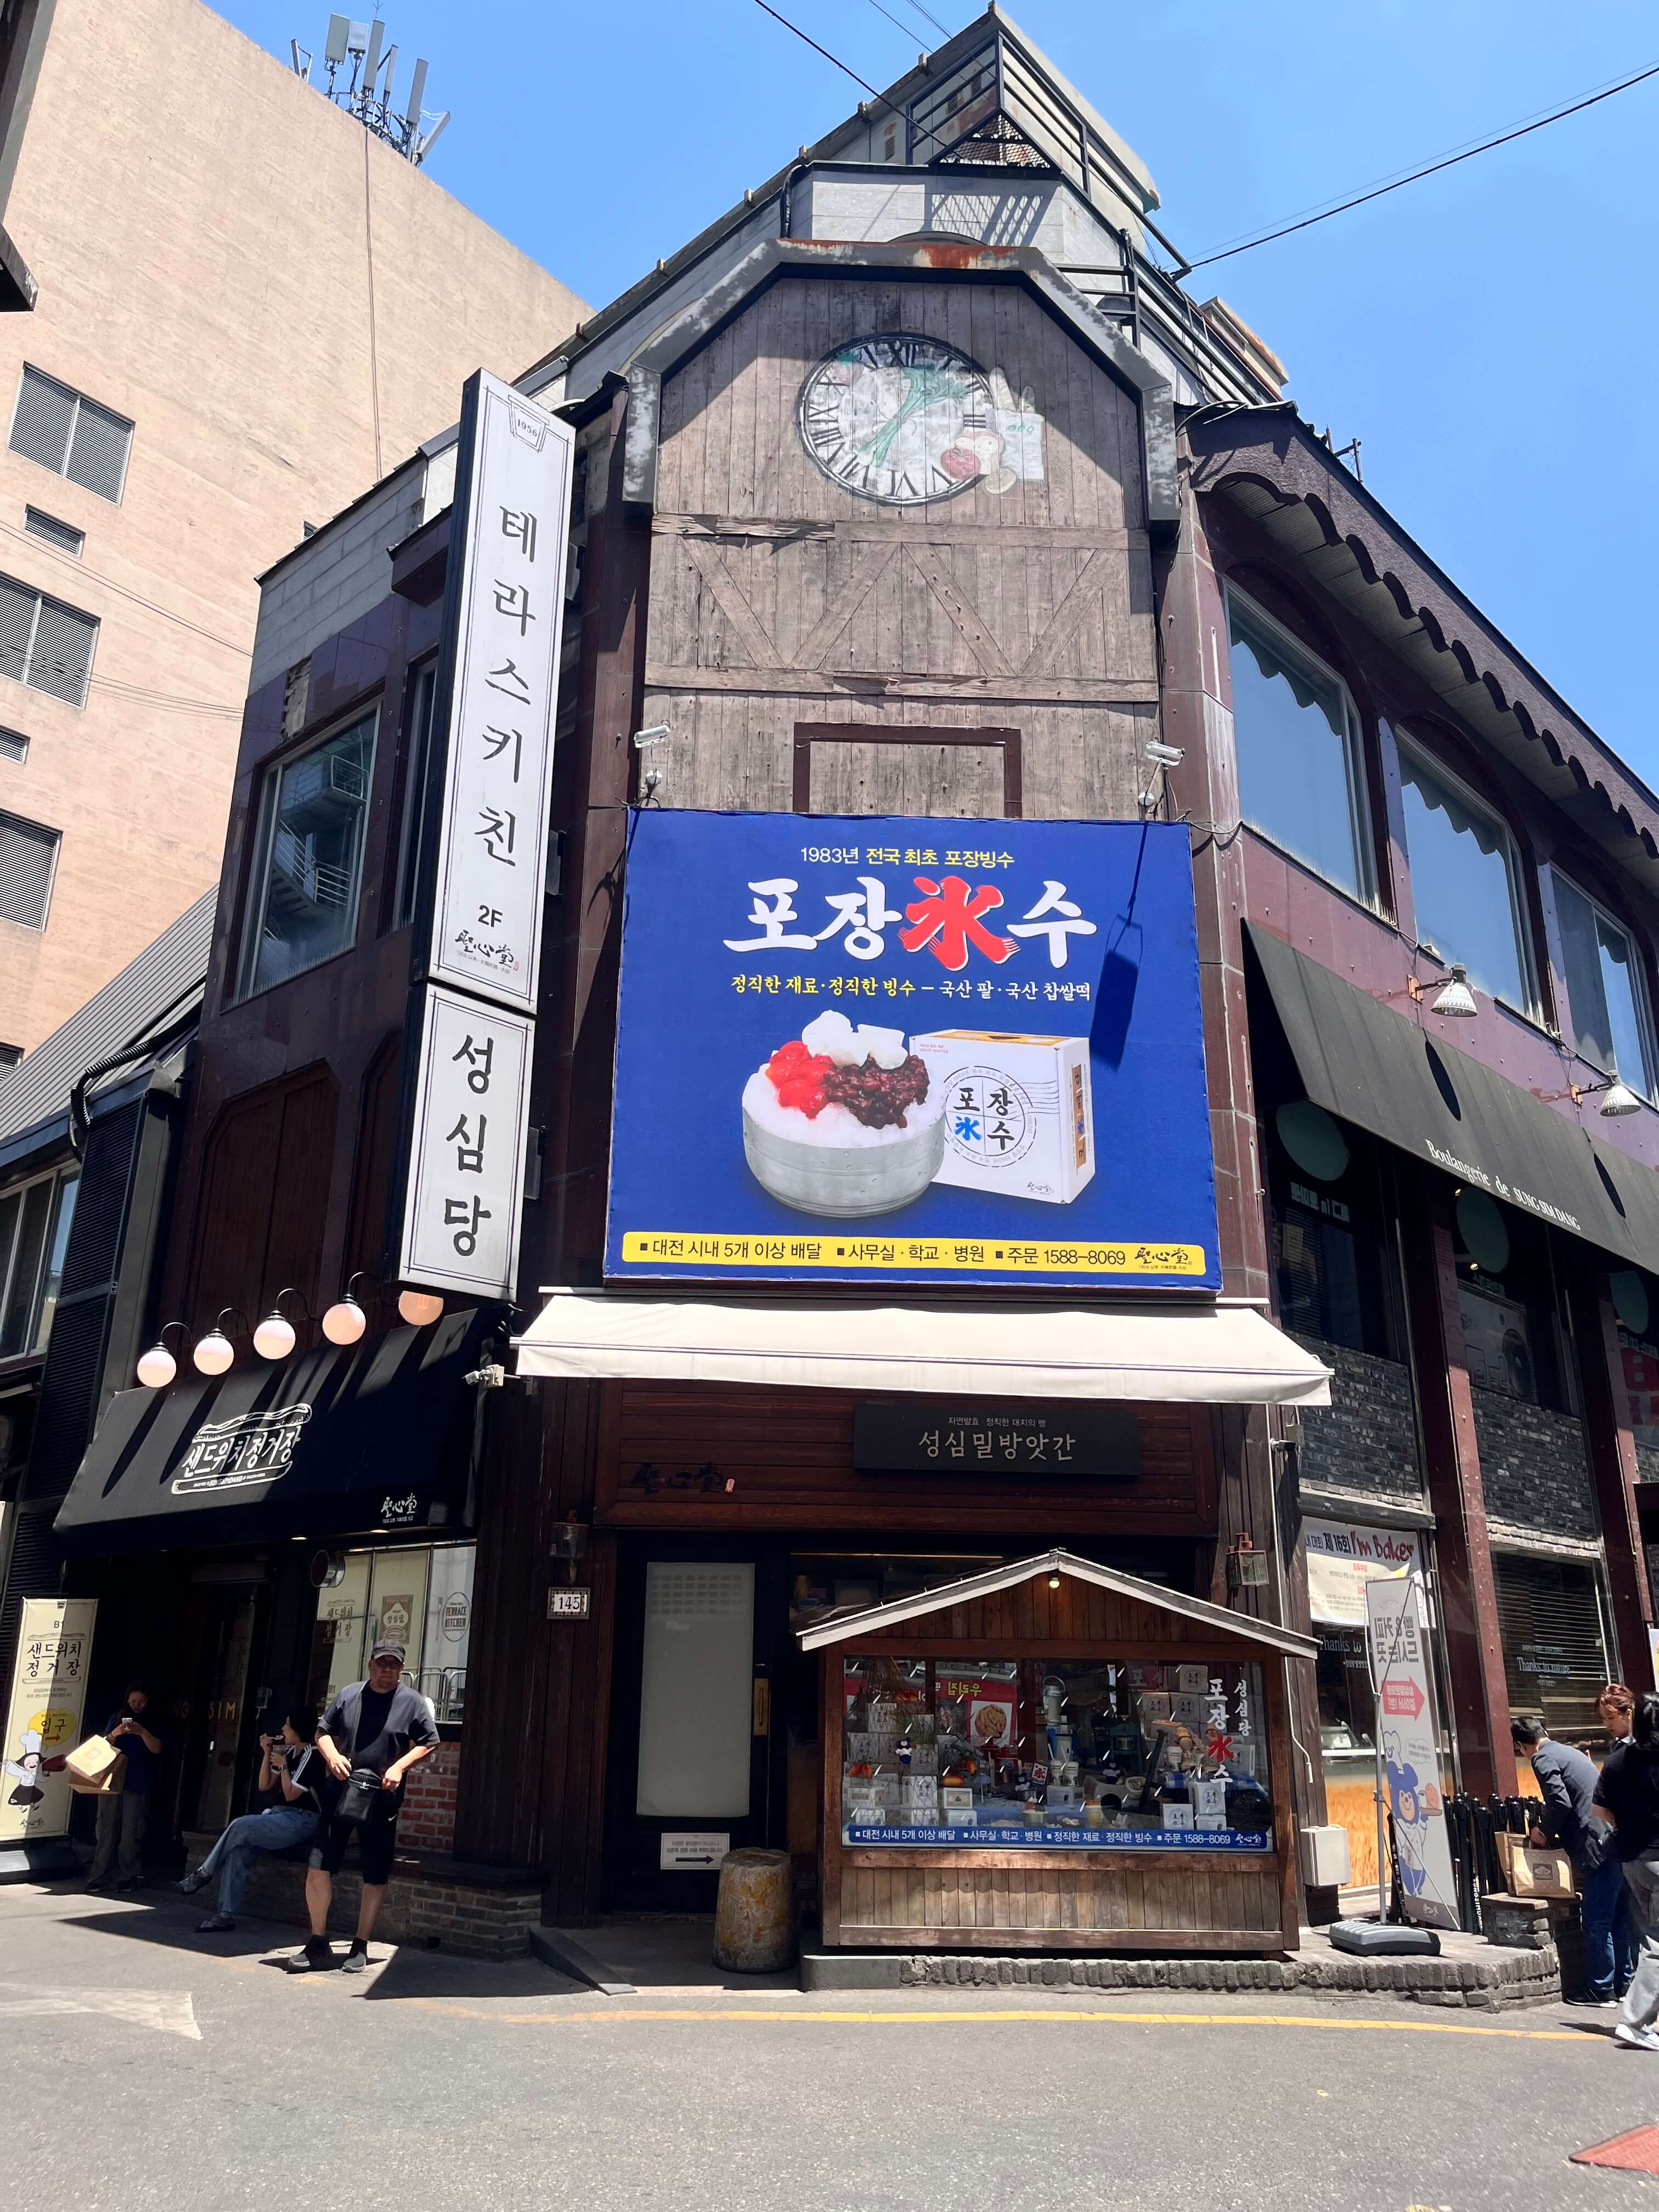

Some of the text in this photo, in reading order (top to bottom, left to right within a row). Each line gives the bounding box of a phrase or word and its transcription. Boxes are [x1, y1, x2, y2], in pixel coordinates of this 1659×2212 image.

[517, 419, 538, 438] 1956
[475, 505, 537, 867] 테라스키친
[801, 847, 1015, 869] 1983년 전국 최초 포장빙수
[478, 904, 503, 928] 2F
[730, 974, 781, 995] 정직한
[883, 978, 916, 997] 빙수
[939, 980, 973, 999] 국산
[1043, 981, 1091, 1002] 찹쌀떡
[444, 1035, 494, 1256] 성심당
[1425, 1138, 1491, 1186] Boulangerie
[1496, 1176, 1510, 1197] de
[653, 1239, 1126, 1265] 대전 시내 5개 이상 배달 사무실 학교 병원 주문 1588-8069
[948, 1417, 979, 1426] 자연발효
[986, 1418, 1009, 1427] 정직한
[182, 1425, 302, 1477] 샌드위치정거장
[918, 1429, 1076, 1462] 성심밀방앗간
[558, 1596, 580, 1610] 145
[27, 1641, 82, 1659] 샌드위치
[1317, 1634, 1362, 1653] Thanks to
[1516, 1657, 1541, 1672] Thanks
[1234, 1679, 1251, 1736] 성심당
[41, 1719, 66, 1734] 입구
[862, 1830, 1231, 1844] 대전 시내 5개 이상 배달 사무실 학교 병원 정직한 재료 정직한 빙수 주문 1588-8069
